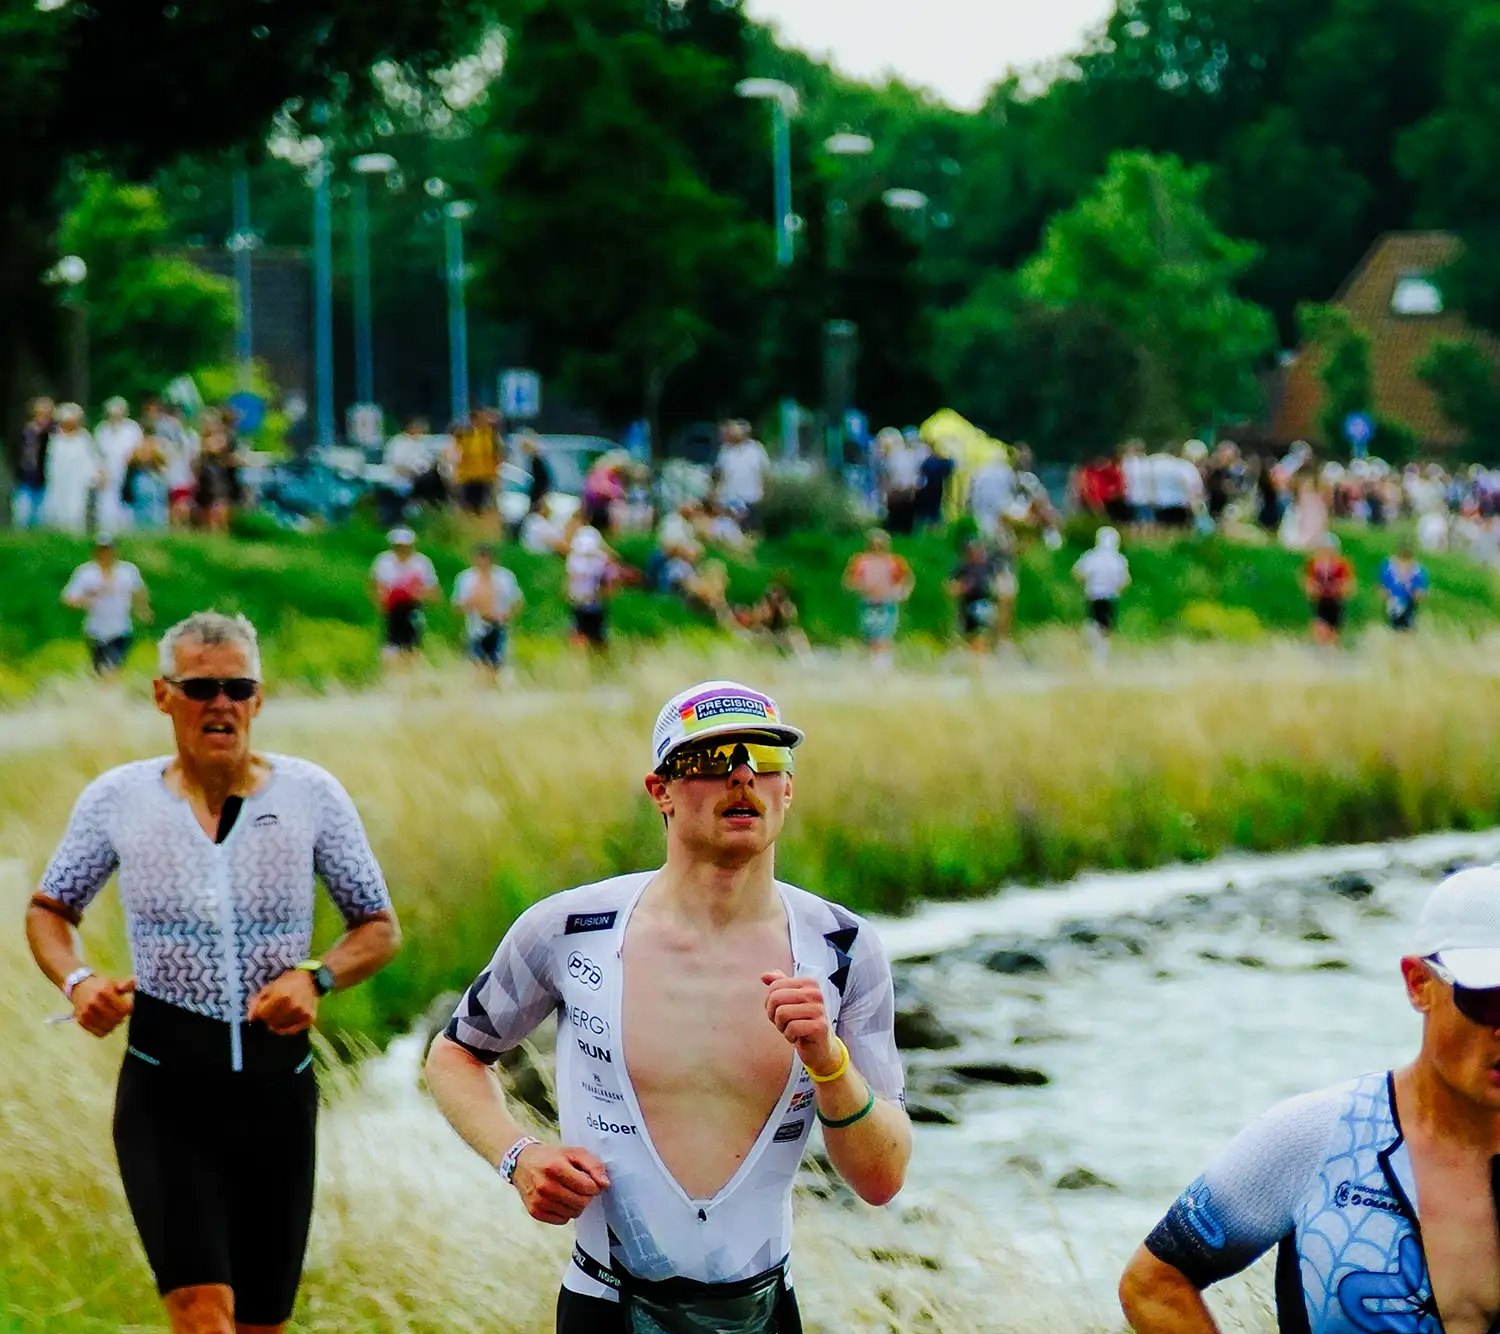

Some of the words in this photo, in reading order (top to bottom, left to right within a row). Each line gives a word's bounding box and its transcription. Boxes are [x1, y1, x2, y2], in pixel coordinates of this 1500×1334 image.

[698, 699, 763, 712] PRECISION
[699, 709, 718, 718] FUEL
[574, 915, 610, 927] FUSION
[569, 955, 601, 985] PTO
[577, 1038, 612, 1063] RUN
[586, 1111, 637, 1135] deboer
